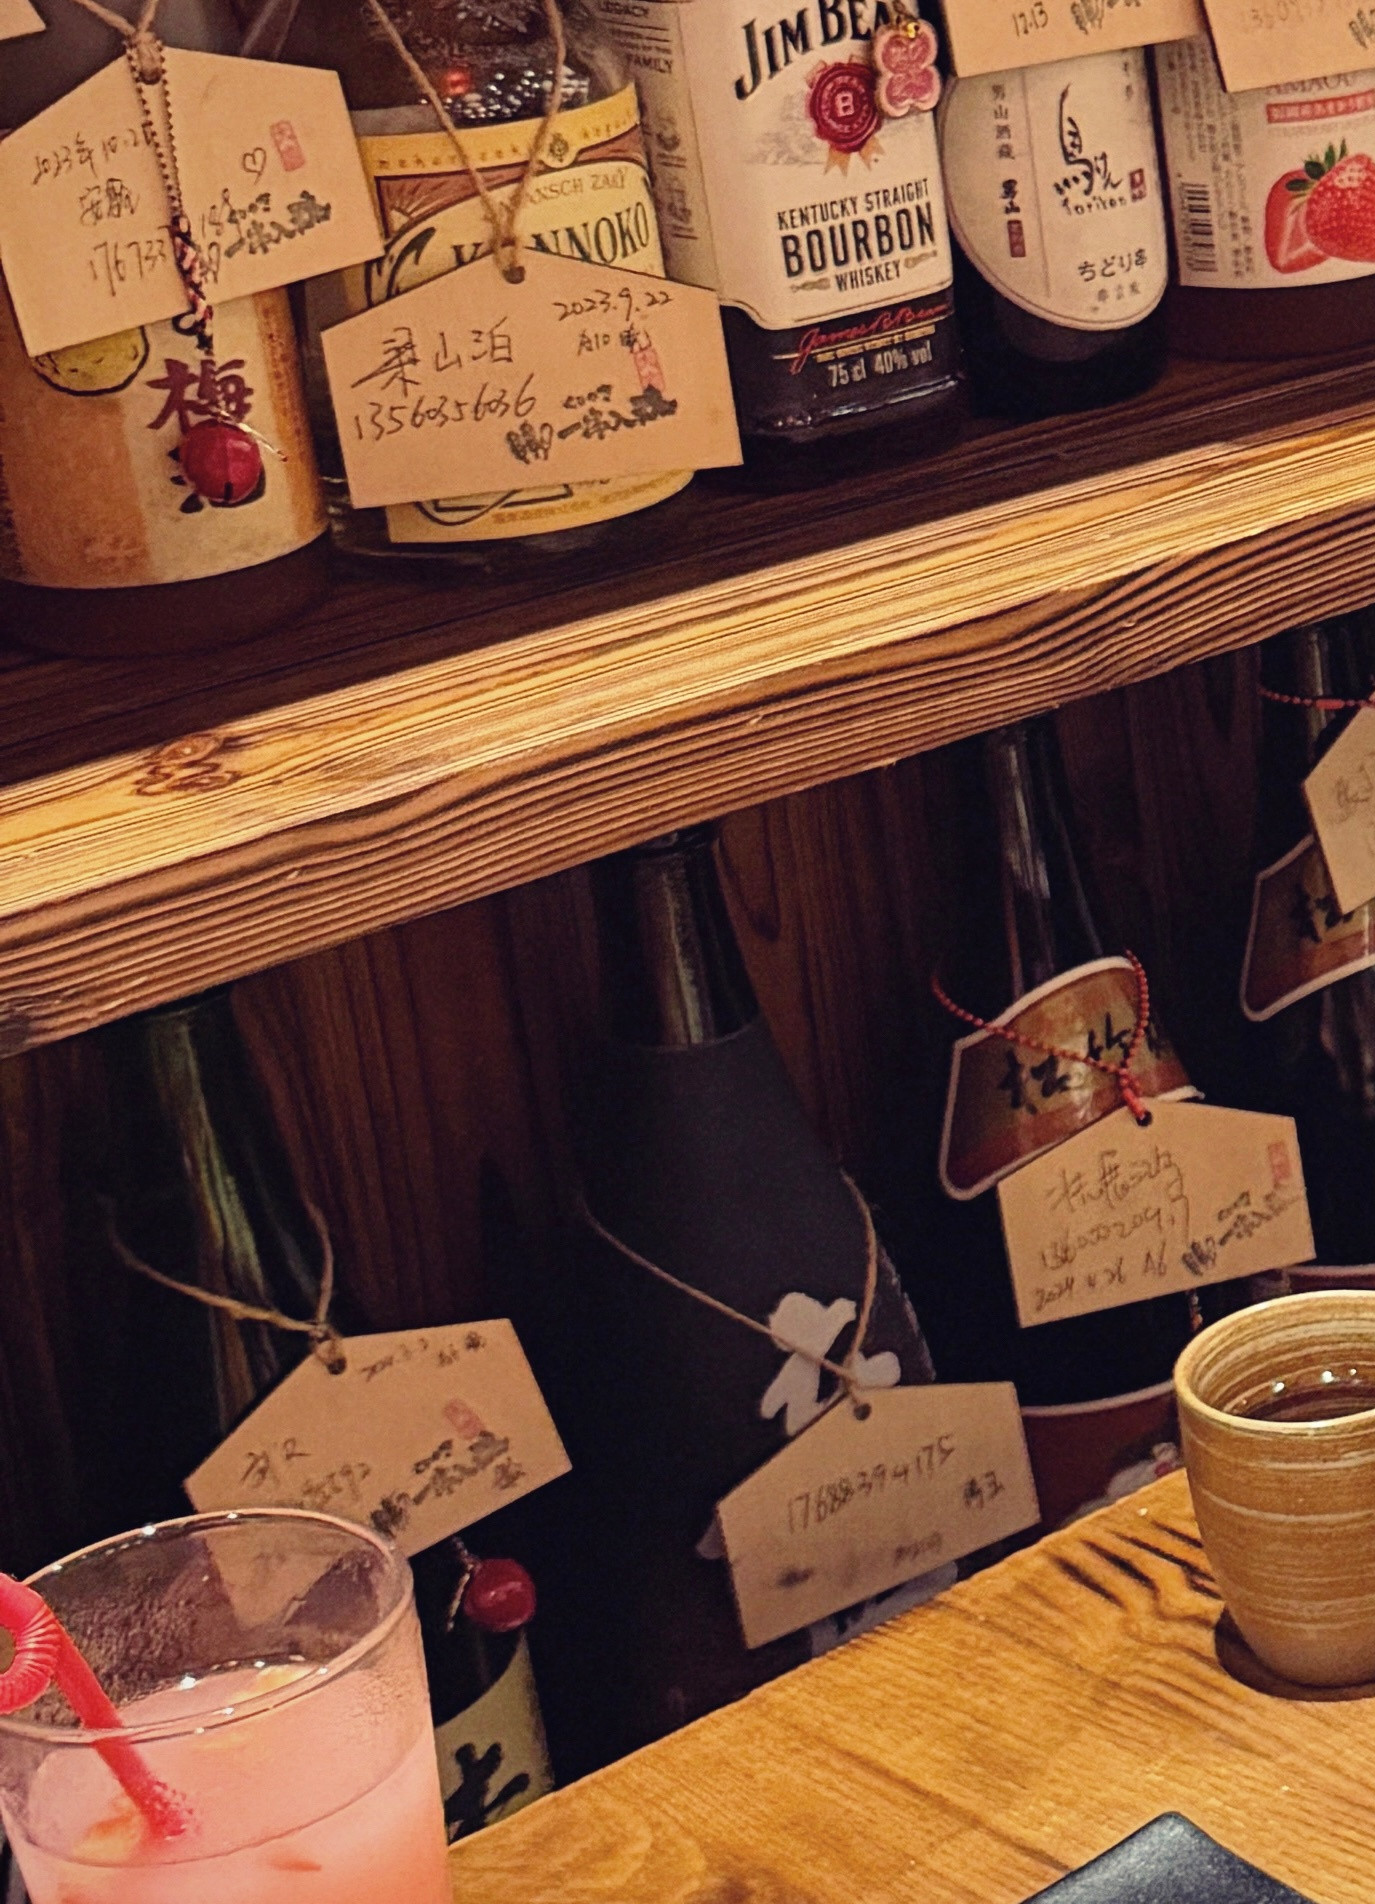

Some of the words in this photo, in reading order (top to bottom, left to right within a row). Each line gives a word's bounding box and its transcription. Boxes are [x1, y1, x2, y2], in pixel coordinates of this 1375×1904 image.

[734, 8, 809, 101] JIM
[776, 195, 858, 231] KENTUCKY
[864, 177, 930, 213] STRAIGHT
[780, 201, 935, 278] BOURBON
[835, 259, 901, 292] WHISKEY
[552, 288, 673, 323] 2023.9.22
[827, 362, 850, 387] 75
[873, 349, 908, 375] 40%
[911, 340, 933, 364] vol
